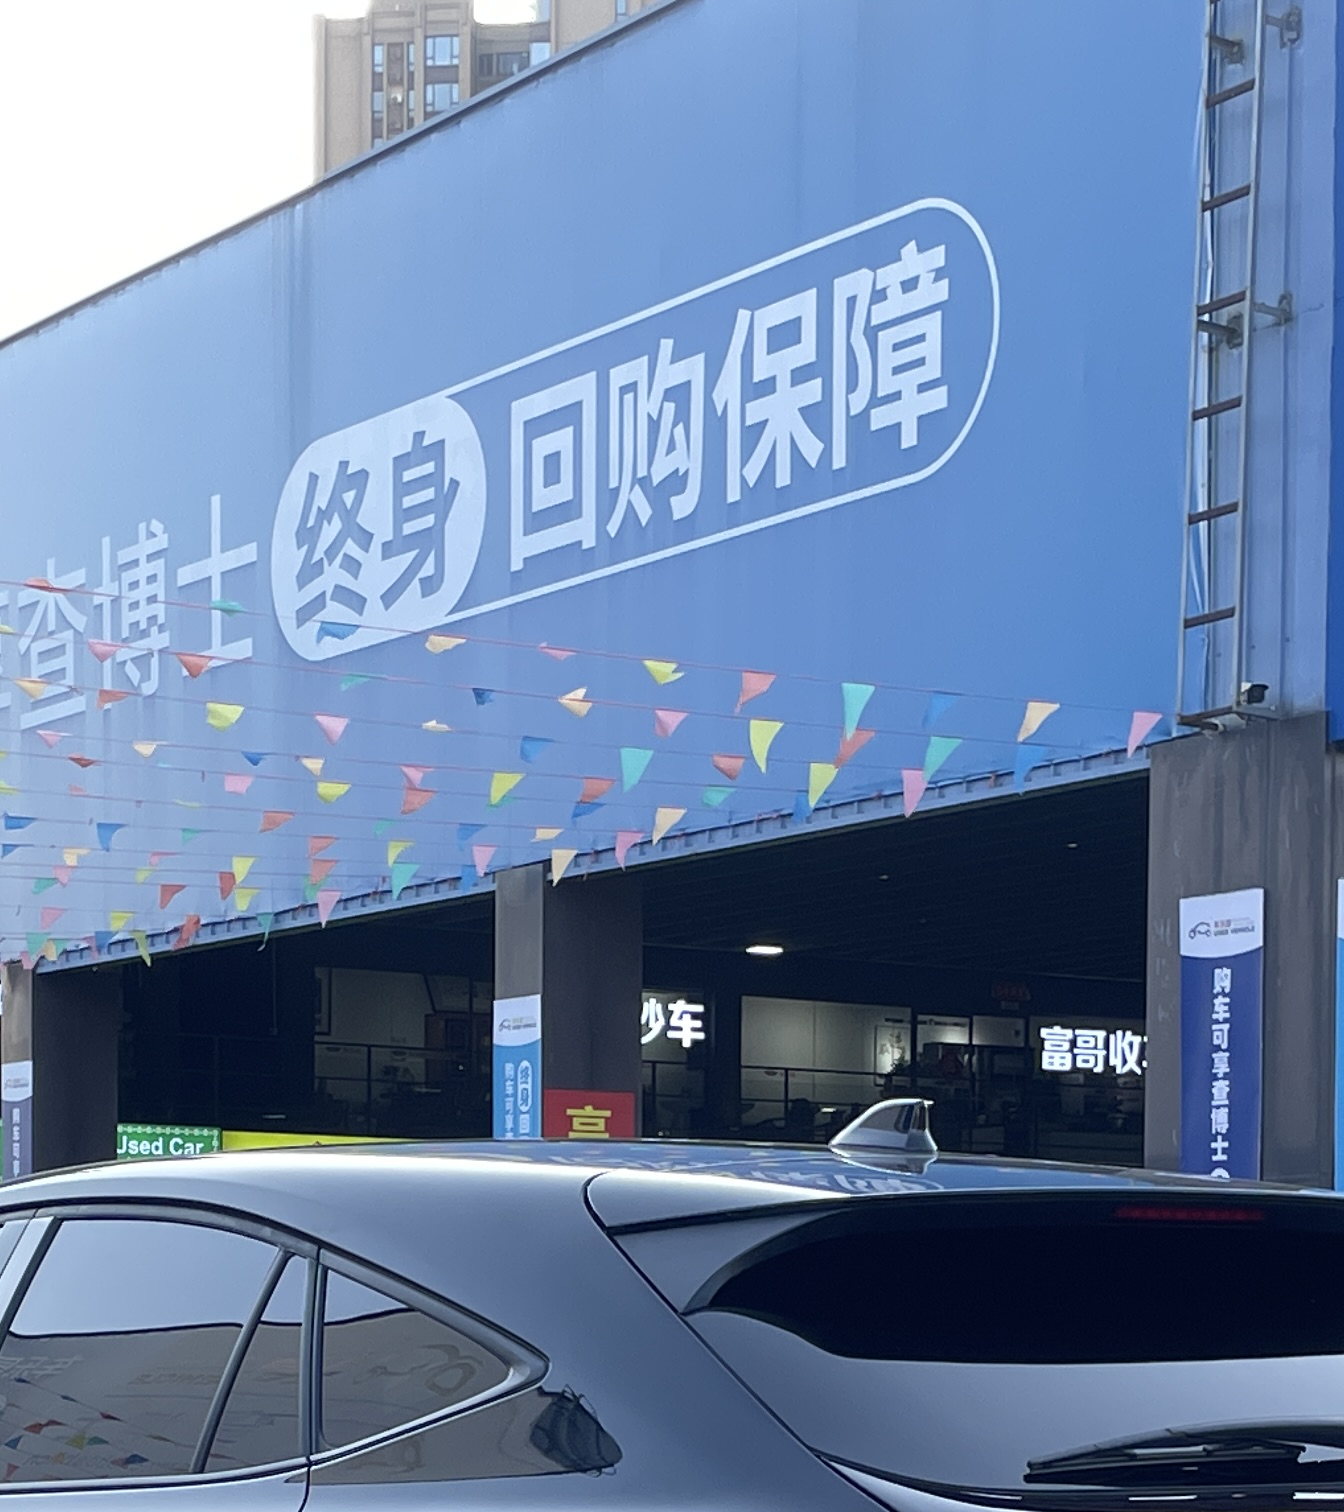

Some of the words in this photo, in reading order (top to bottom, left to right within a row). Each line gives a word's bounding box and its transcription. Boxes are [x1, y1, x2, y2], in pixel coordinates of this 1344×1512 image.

[295, 429, 462, 628] 终身
[509, 240, 951, 573] 回购保障
[1039, 1024, 1149, 1075] 富哥收
[1210, 967, 1232, 1162] 购车可享查博士
[169, 1137, 205, 1156] Car
